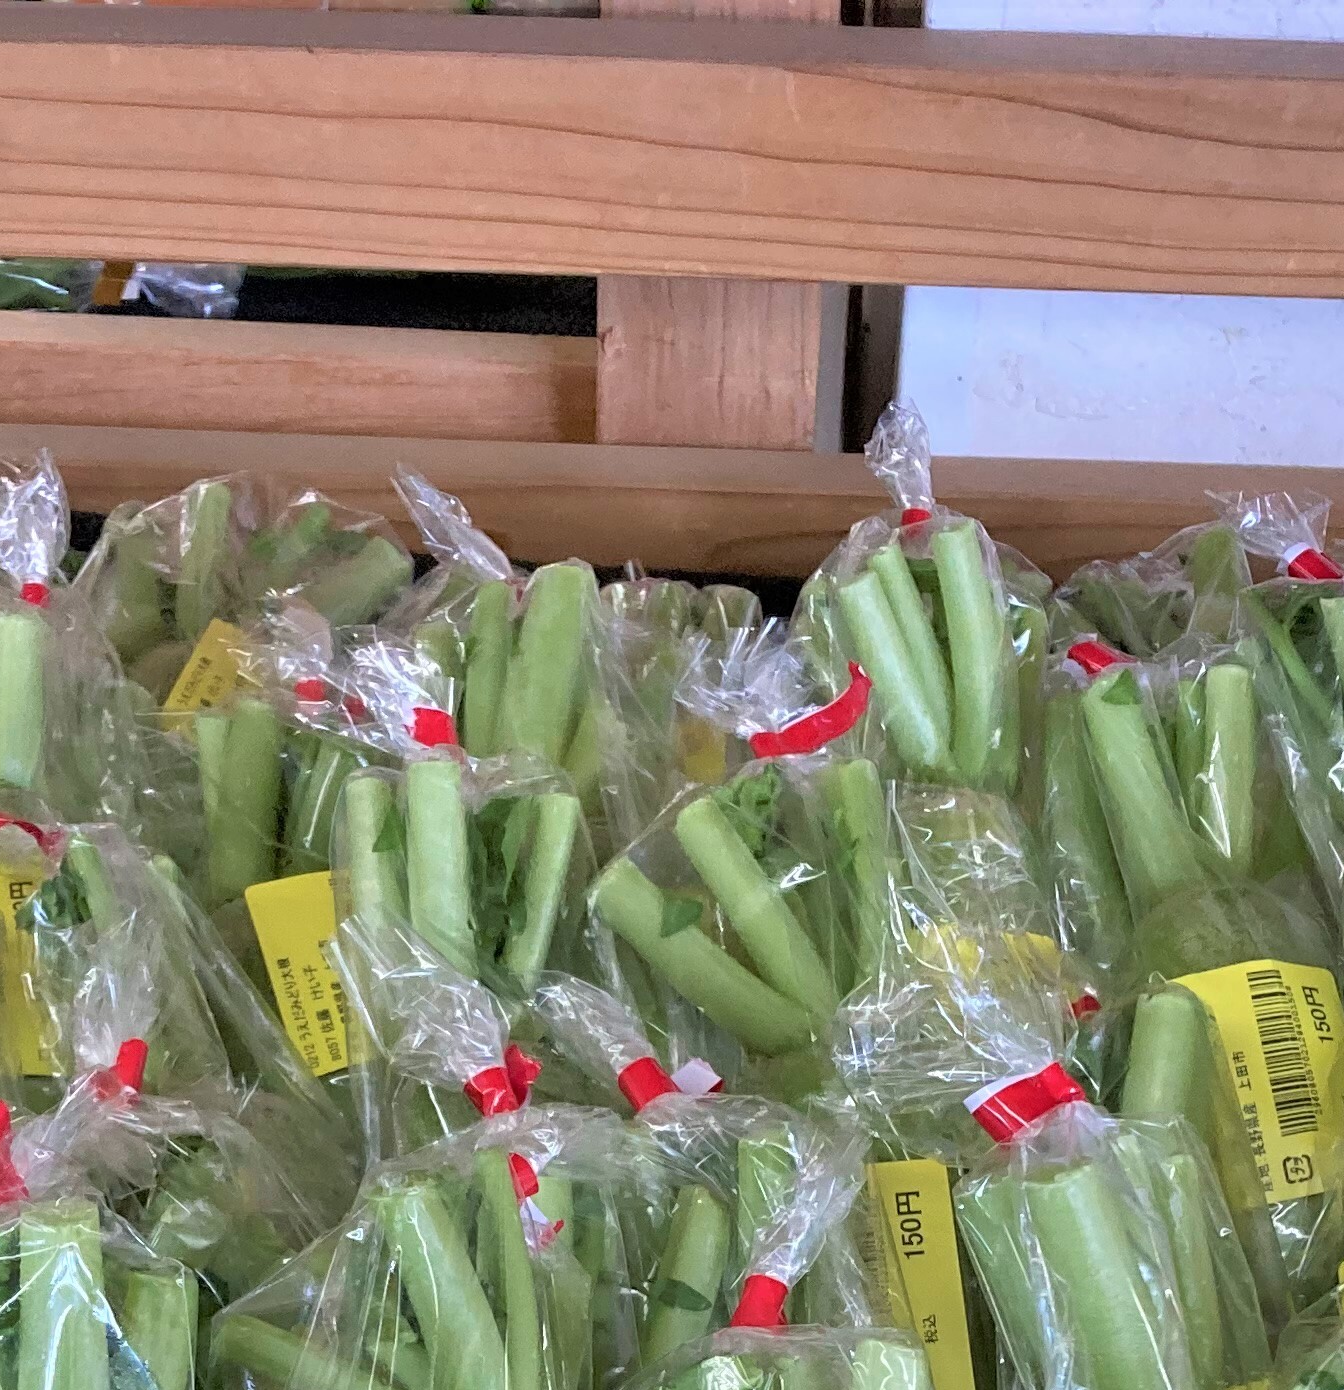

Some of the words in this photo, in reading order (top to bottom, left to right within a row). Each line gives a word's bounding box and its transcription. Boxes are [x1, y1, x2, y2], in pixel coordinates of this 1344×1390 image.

[275, 956, 312, 1041] うえだみどり大根
[301, 964, 324, 1001] けい子
[315, 1007, 335, 1033] 佐藤
[1300, 985, 1334, 1043] 150円
[302, 1042, 320, 1071] 0212
[324, 1036, 342, 1062] 8057
[1231, 1050, 1252, 1091] 上田市
[894, 1190, 925, 1259] 150円
[921, 1313, 939, 1346] 税込
